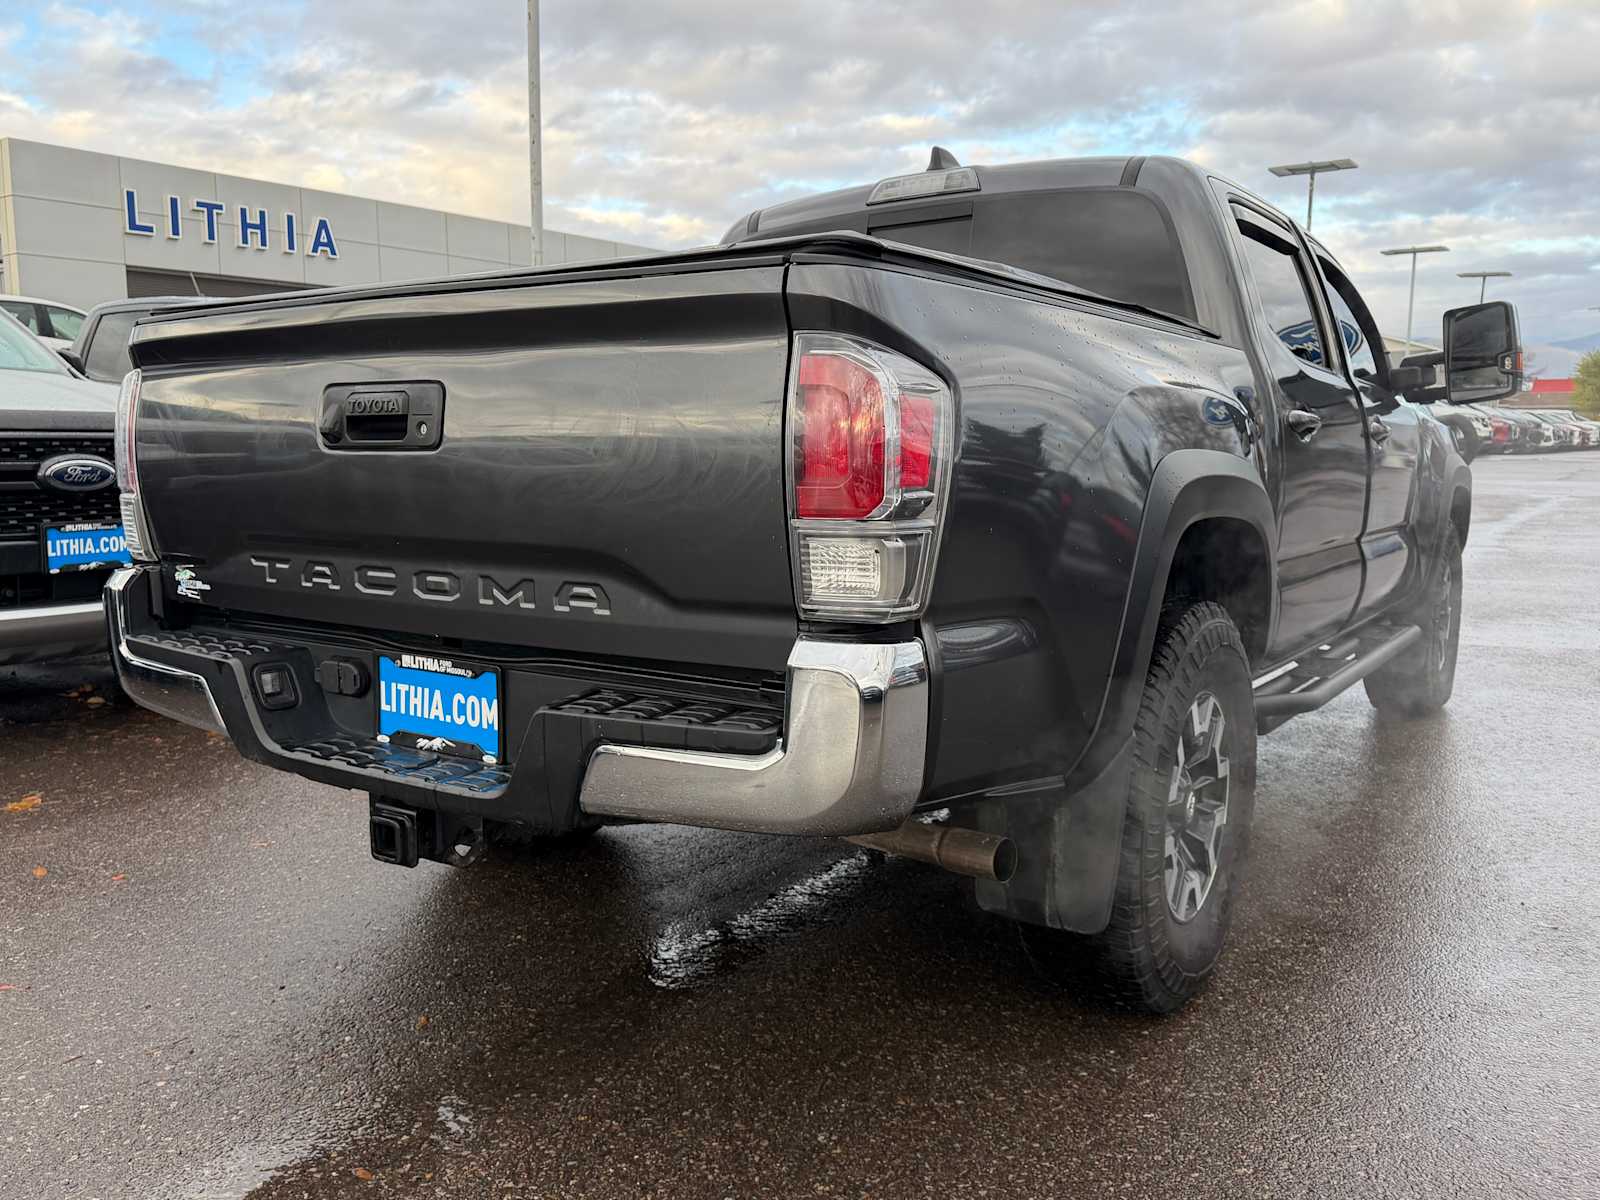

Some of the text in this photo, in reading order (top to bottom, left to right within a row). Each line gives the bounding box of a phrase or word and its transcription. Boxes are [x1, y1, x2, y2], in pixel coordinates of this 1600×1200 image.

[124, 188, 339, 259] LITHIA
[348, 399, 402, 414] TOYOTA
[64, 465, 102, 482] Ford
[250, 555, 612, 616] TACOMA
[411, 655, 440, 672] LITHIA
[380, 680, 498, 731] LITHIA.COM
